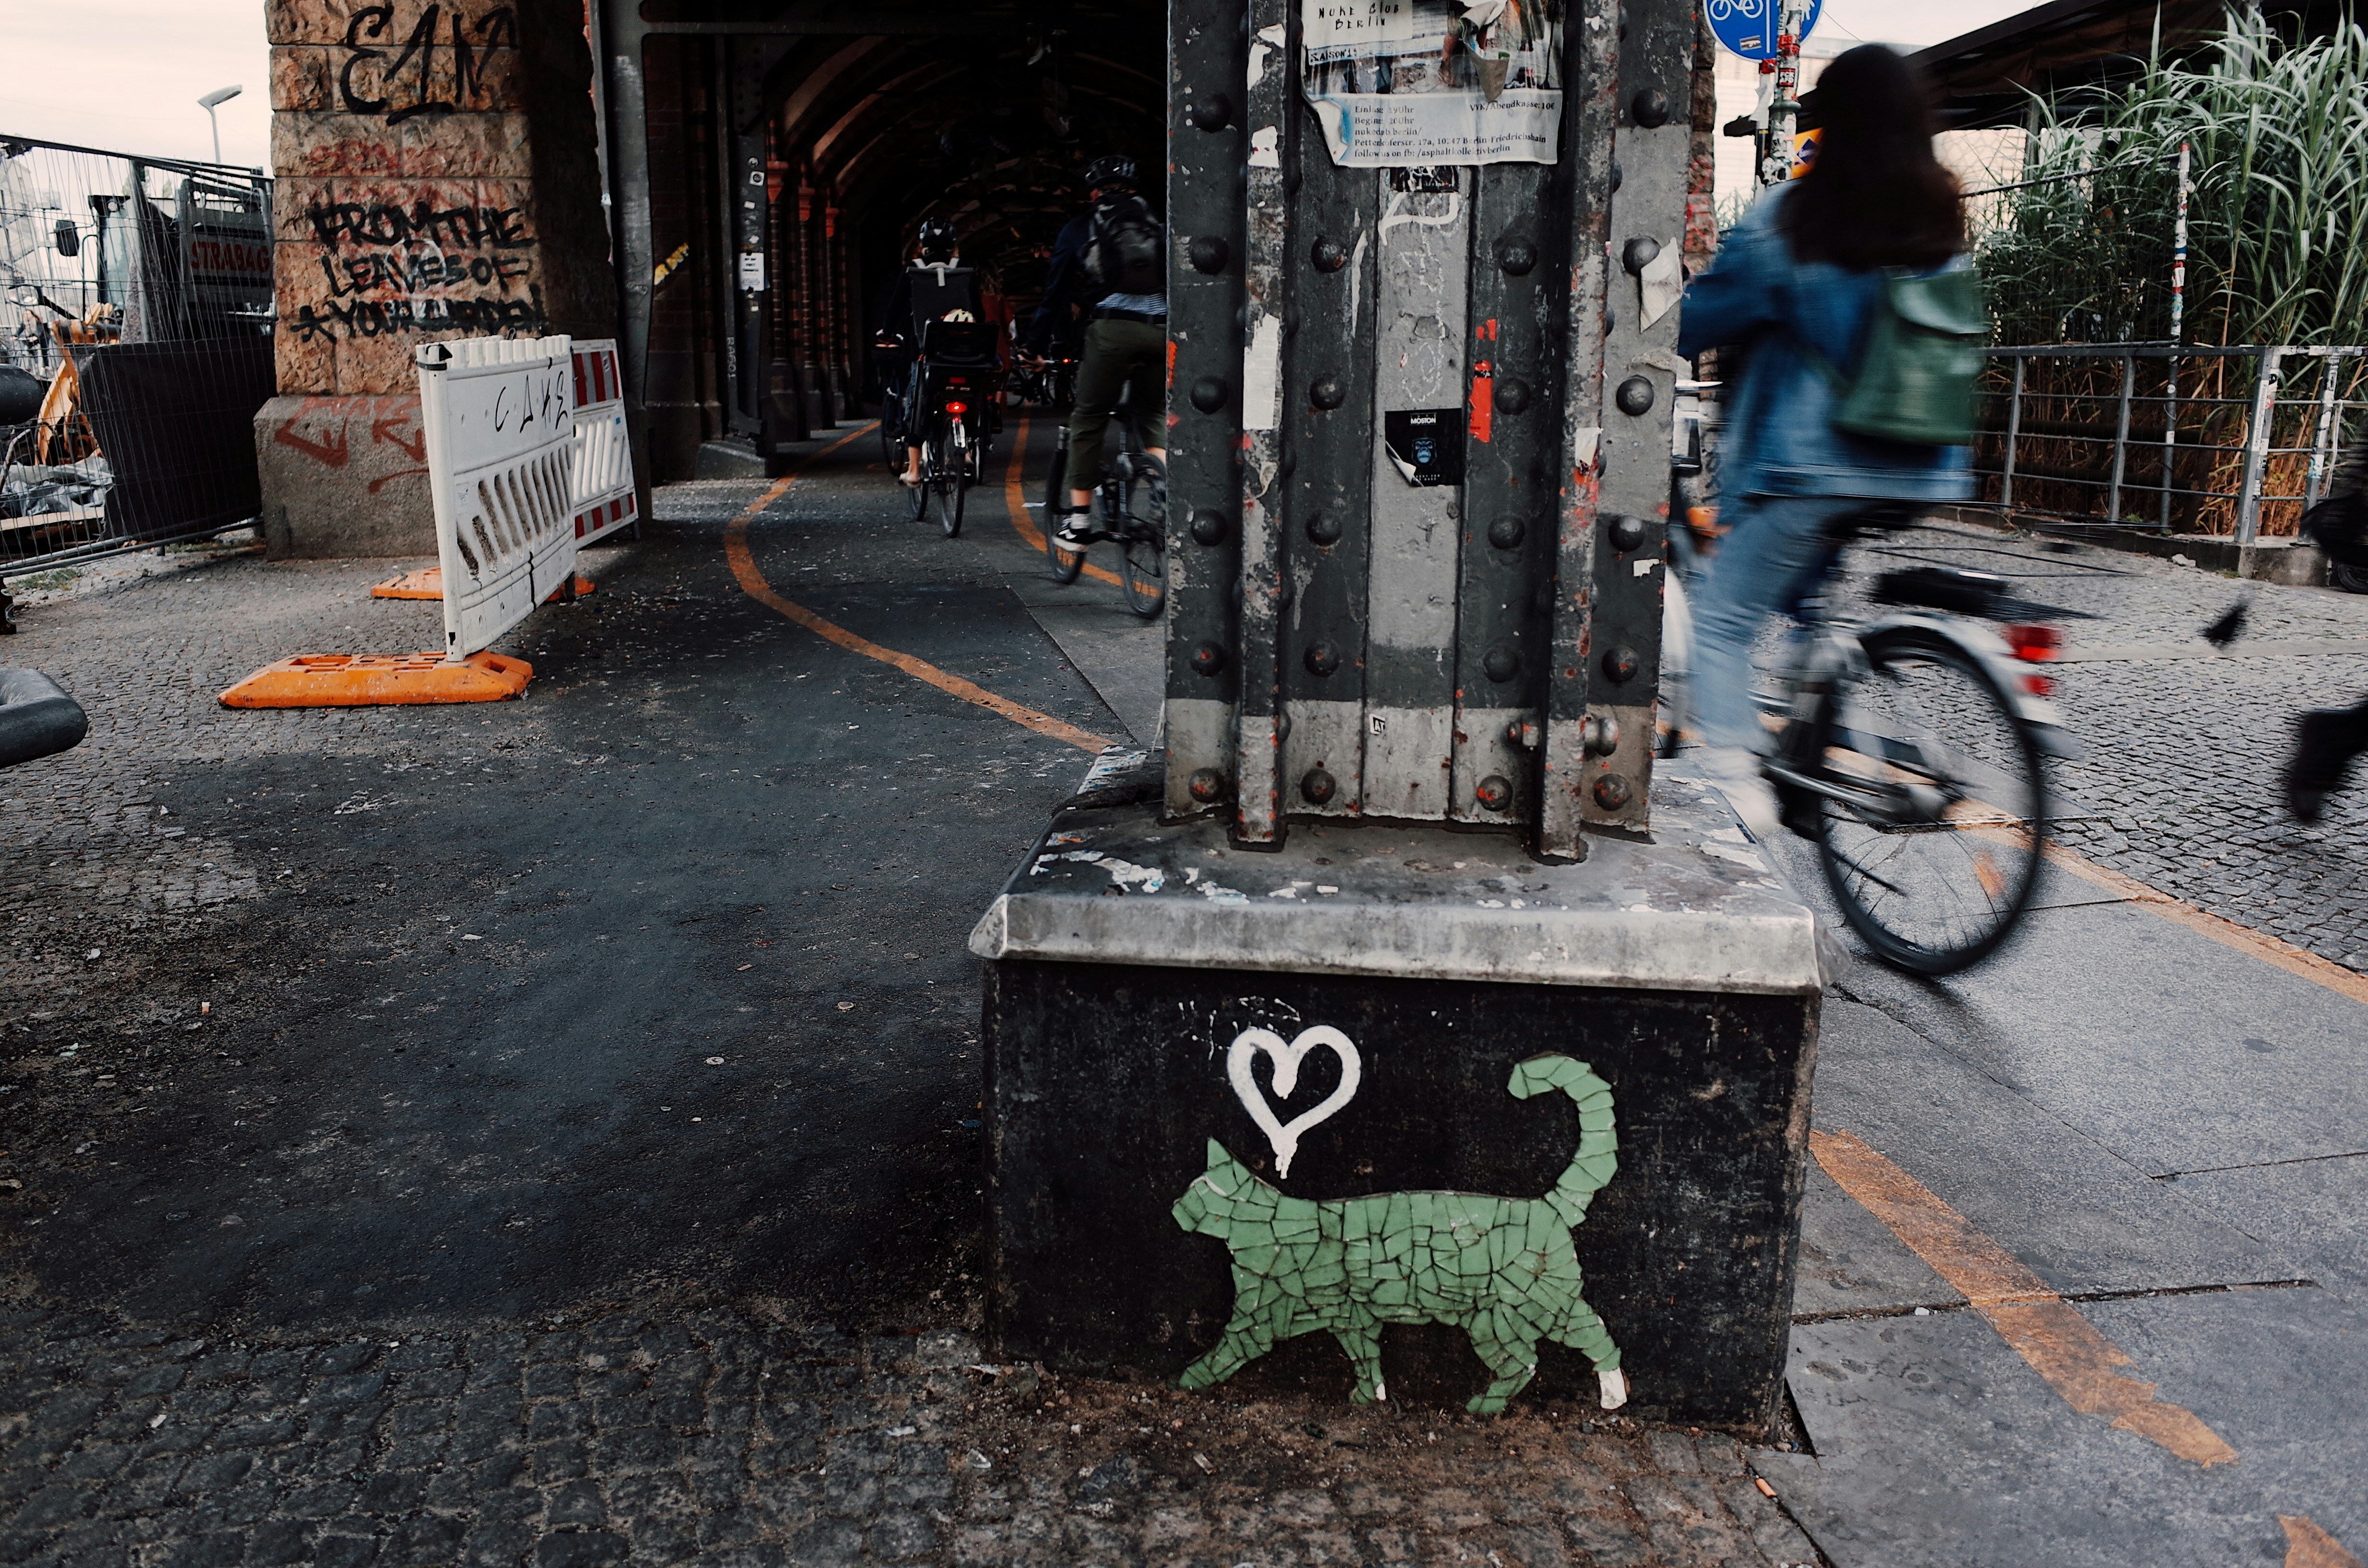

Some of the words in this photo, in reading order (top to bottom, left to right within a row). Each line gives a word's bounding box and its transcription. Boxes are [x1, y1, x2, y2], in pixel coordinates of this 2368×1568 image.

[1319, 6, 1355, 19] NUKE
[1355, 149, 1379, 157] follow
[191, 241, 270, 272] STRABAG
